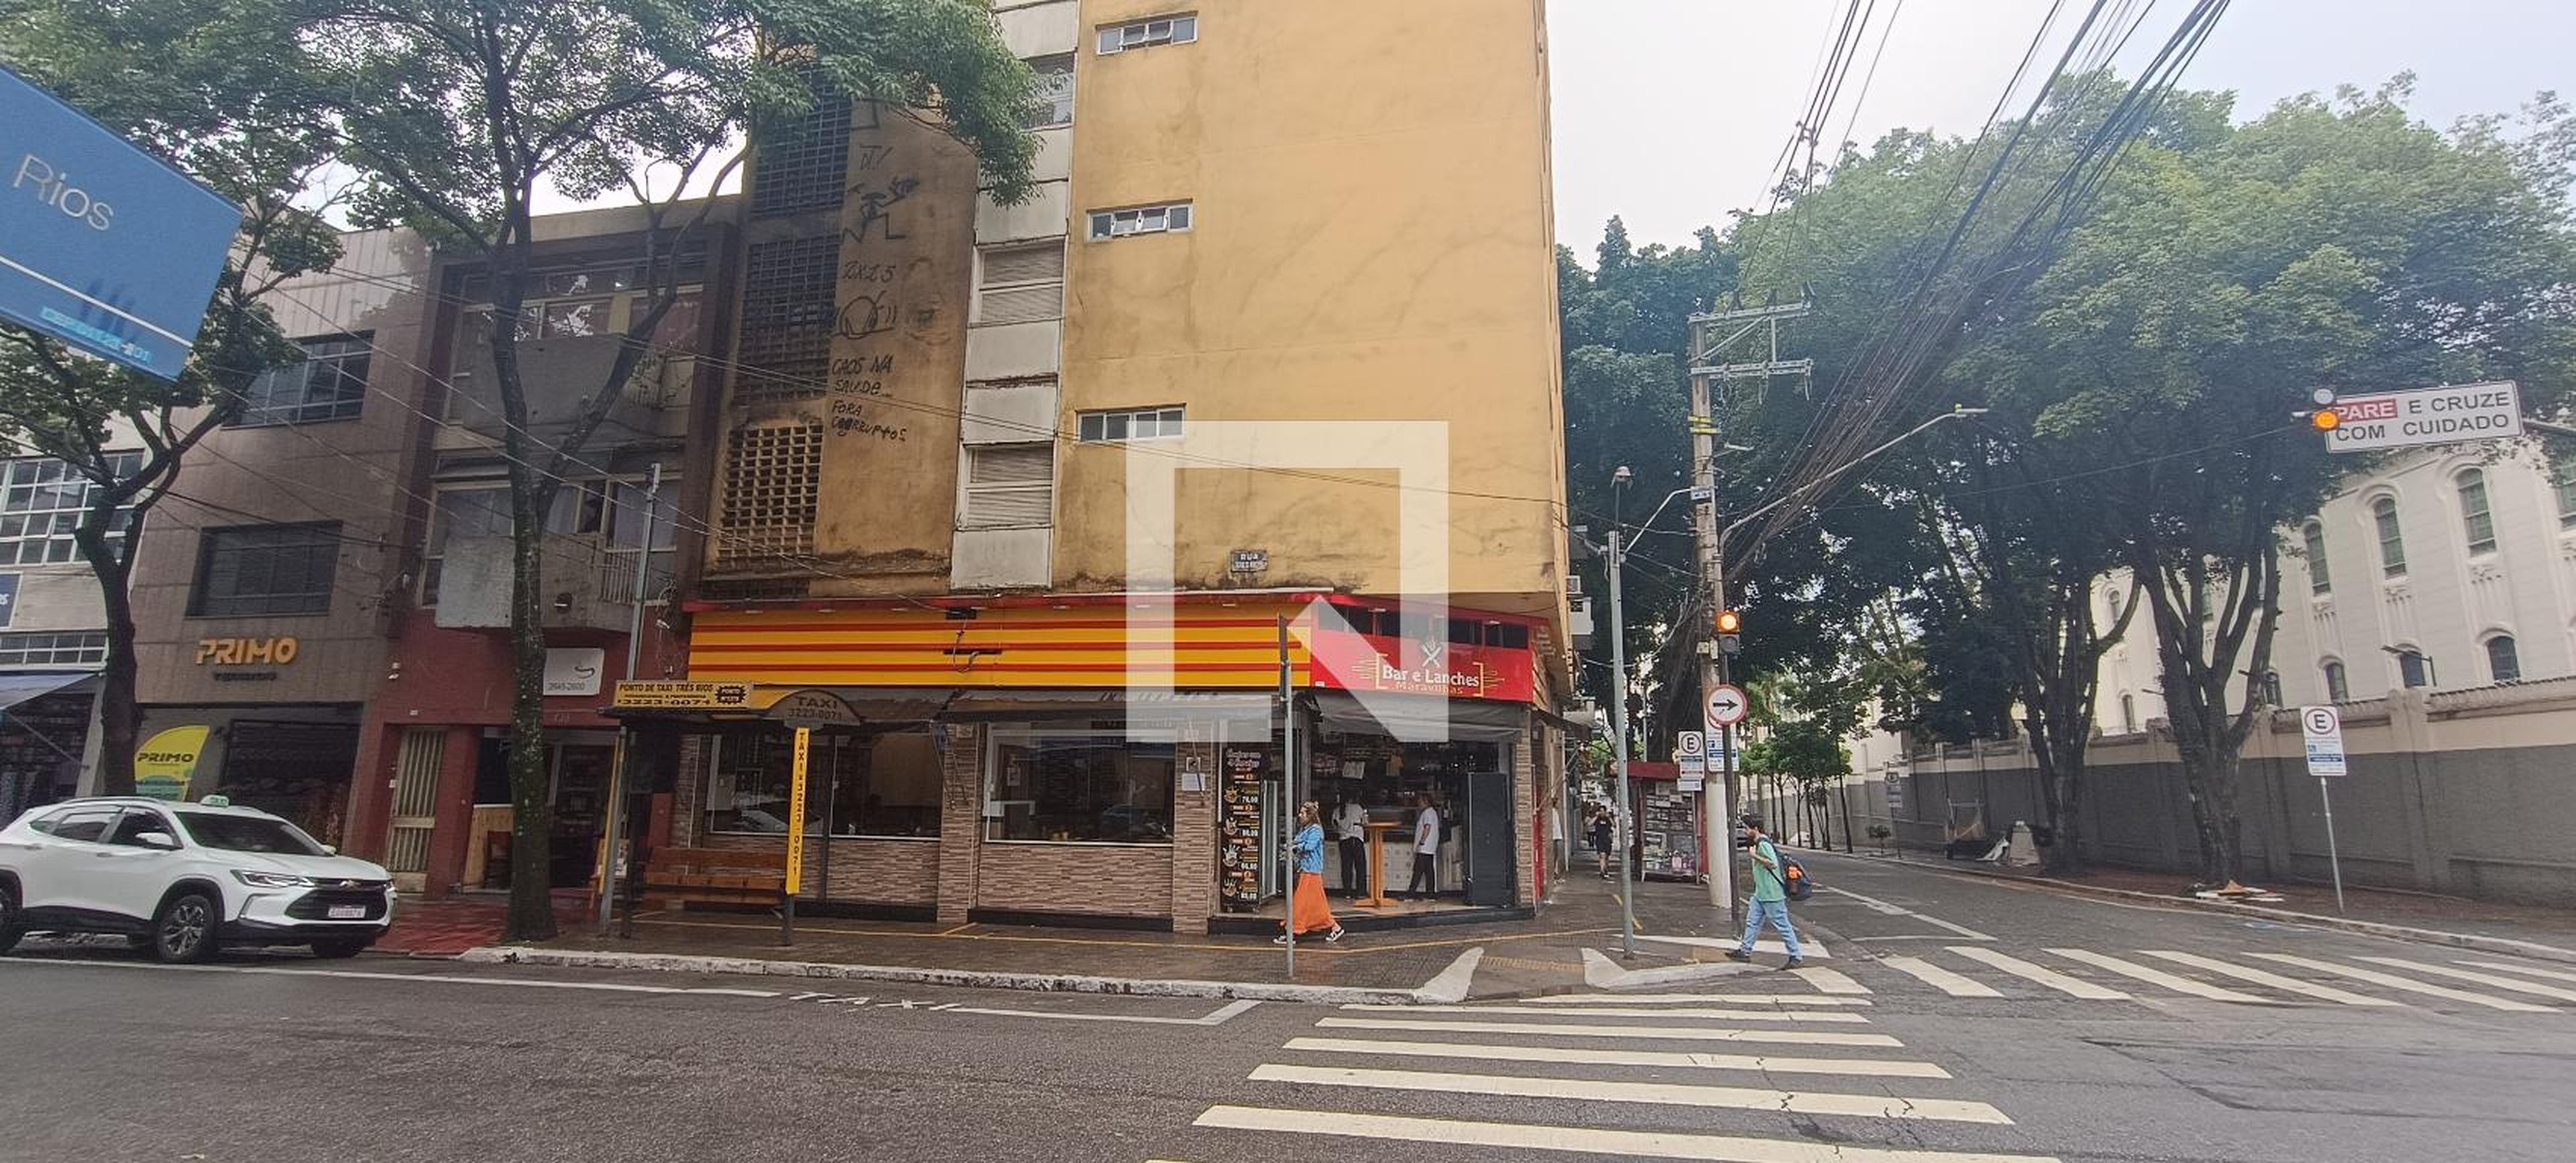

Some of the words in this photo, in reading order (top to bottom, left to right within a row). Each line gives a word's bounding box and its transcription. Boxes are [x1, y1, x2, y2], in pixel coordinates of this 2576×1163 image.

[13, 154, 114, 231] Rios
[2334, 400, 2397, 420] PARE
[2408, 399, 2422, 414] E
[2431, 391, 2510, 411] CRUZE
[2335, 424, 2385, 441] COM
[2402, 413, 2510, 436] CUIDADO
[195, 638, 297, 664] PRIMO
[1382, 664, 1408, 680] Bar
[1412, 670, 1421, 682] e
[1425, 669, 1480, 687] Lanches
[794, 696, 838, 709] TAXI
[2314, 714, 2327, 729] E
[798, 732, 806, 772] TAXI
[1686, 737, 1695, 750] E
[137, 752, 194, 762] PRIMO
